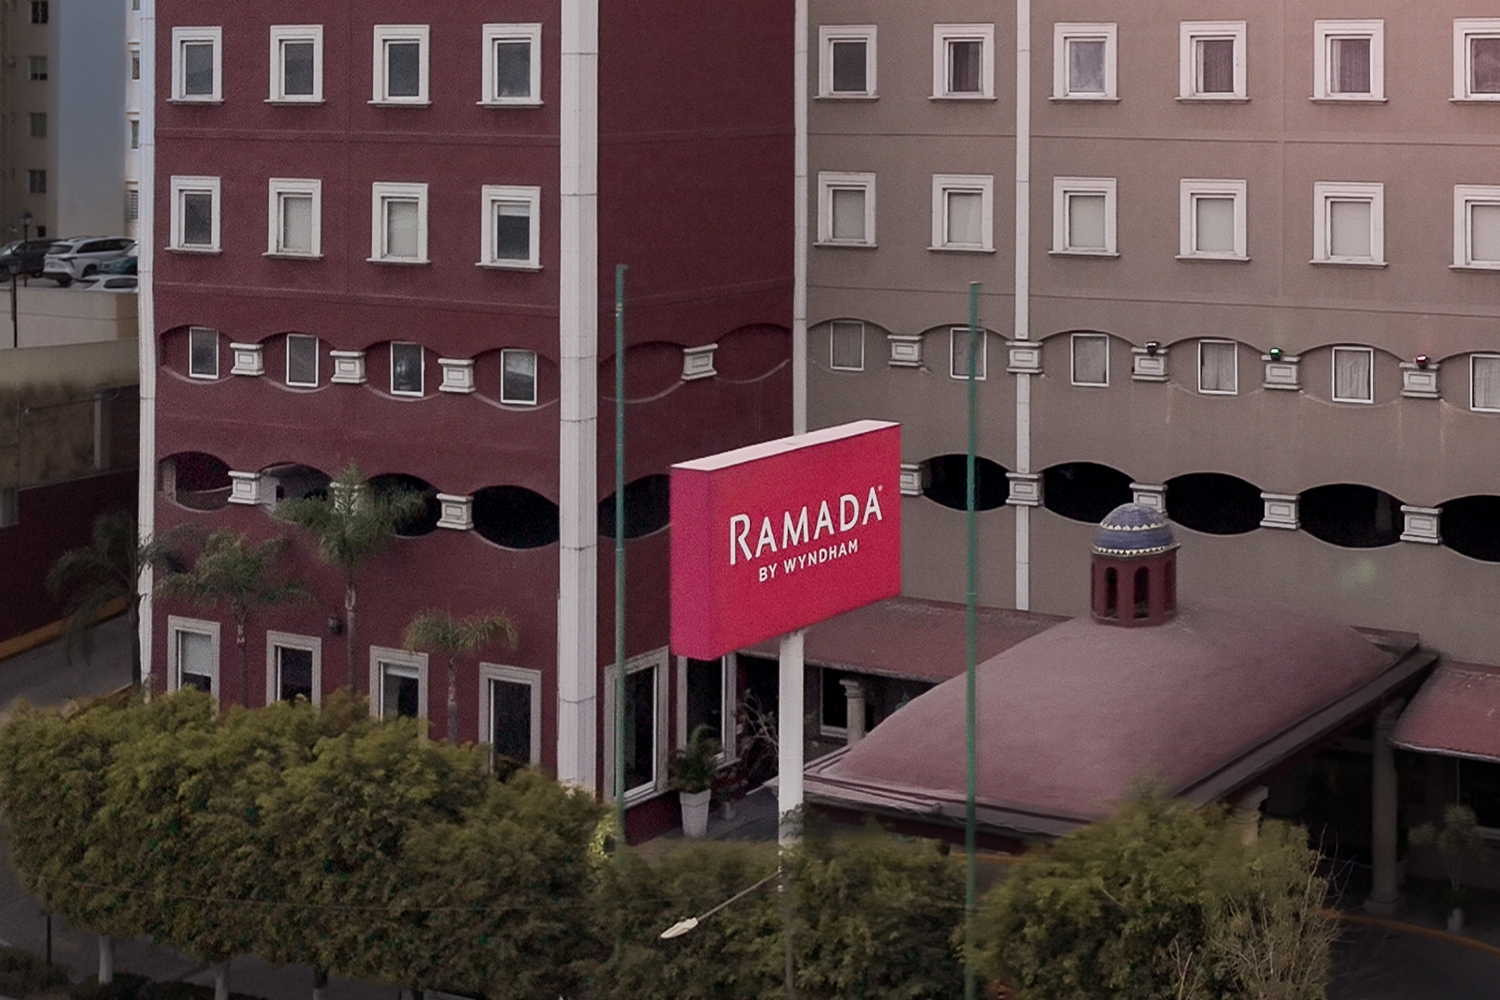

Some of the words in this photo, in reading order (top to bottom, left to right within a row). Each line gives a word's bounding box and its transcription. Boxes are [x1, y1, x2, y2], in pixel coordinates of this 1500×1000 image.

[729, 486, 883, 566] RAMADA
[758, 563, 778, 582] BY
[783, 538, 858, 574] WYNDHAM
